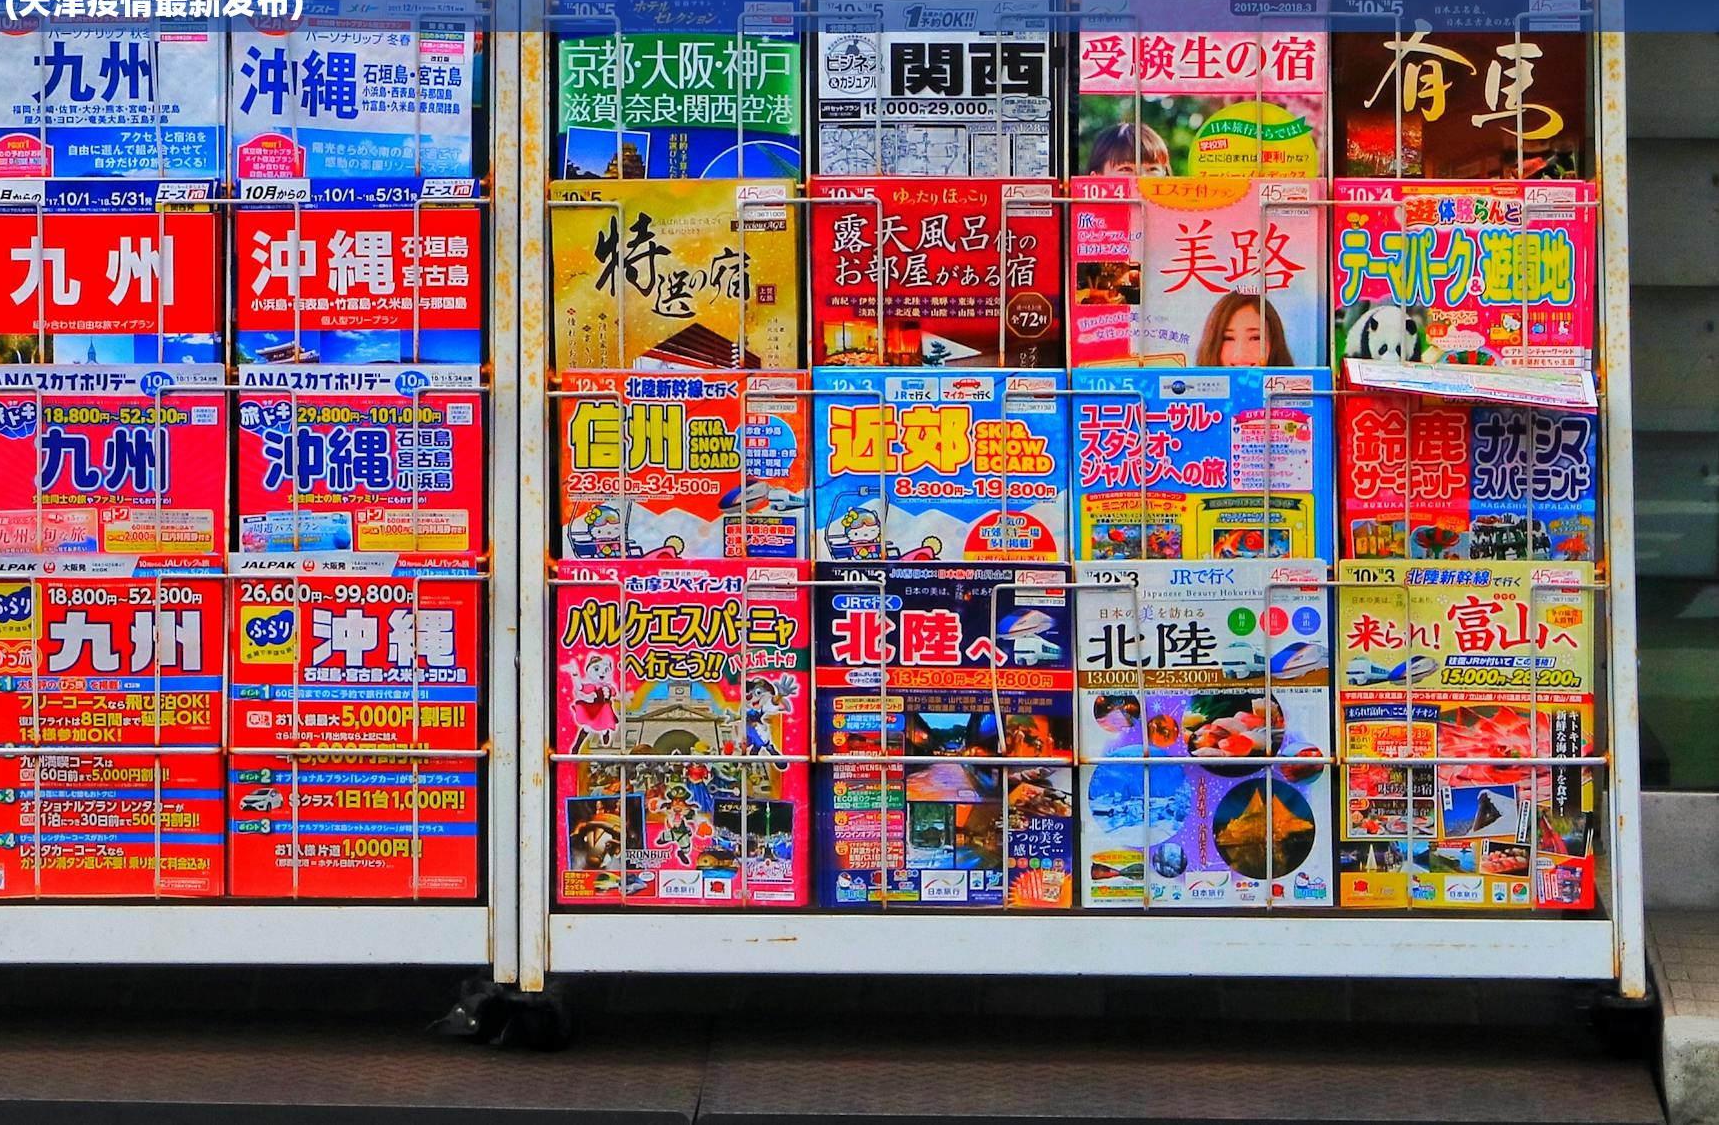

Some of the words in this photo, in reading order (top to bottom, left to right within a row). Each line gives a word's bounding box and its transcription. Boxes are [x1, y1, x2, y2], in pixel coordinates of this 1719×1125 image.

[563, 39, 793, 90] 京都・大阪・神戸
[889, 43, 1045, 98] 関西
[1080, 34, 1317, 82] 受験生の宿
[240, 46, 359, 122] 沖縄
[1150, 182, 1236, 199] エステ付プラン
[400, 236, 469, 258] 石垣島
[832, 212, 1038, 254] 露天風呂付の
[9, 235, 175, 308] 九州
[250, 229, 395, 298] 沖縄
[594, 212, 753, 320] 特選の宿
[834, 253, 1037, 288] お部屋がある宿
[1159, 218, 1308, 296] 美路
[1340, 227, 1476, 306] テーマパーク
[321, 315, 399, 327] 個人型フリープラン
[625, 378, 738, 400] 北陸新幹線で行く
[262, 427, 392, 492] 沖縄
[569, 403, 686, 473] 信州
[689, 436, 734, 453] SNOW
[828, 404, 974, 476] 近郊
[1352, 409, 1469, 467] 鈴鹿
[689, 453, 741, 471] BOARD
[1352, 467, 1469, 502] サーキット
[1474, 467, 1591, 502] スパーランド
[625, 575, 743, 594] 志摩スペイン村
[1169, 568, 1236, 586] JRで行く
[1405, 568, 1523, 588] 北陸新幹線で行く
[49, 611, 202, 673] 九州
[312, 610, 456, 668] 沖縄
[562, 599, 798, 648] パルケエスパーニャ
[1086, 622, 1222, 669] 北陸
[665, 884, 696, 895] 日本旅行
[926, 887, 962, 897] 日本旅行
[1190, 888, 1225, 899] 日本旅行
[1449, 890, 1479, 901] 日本旅行
